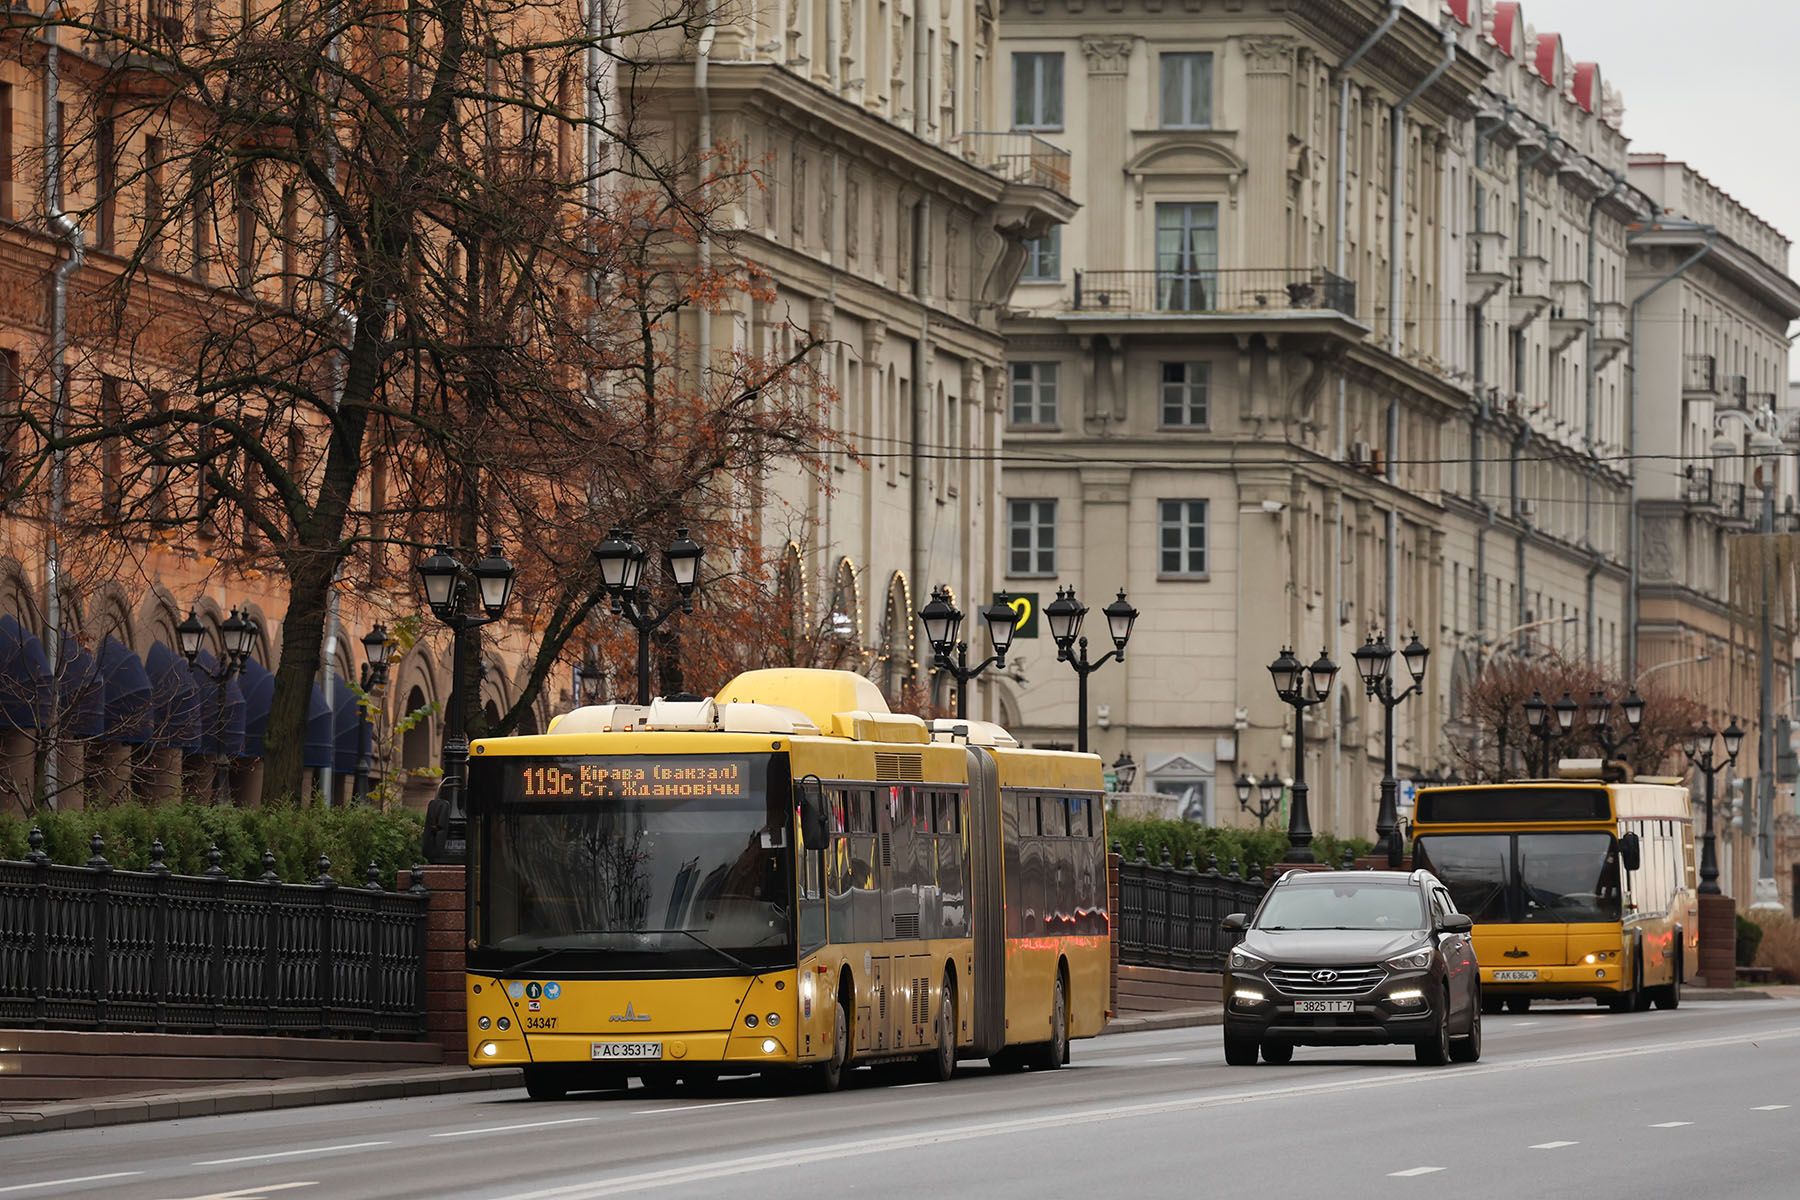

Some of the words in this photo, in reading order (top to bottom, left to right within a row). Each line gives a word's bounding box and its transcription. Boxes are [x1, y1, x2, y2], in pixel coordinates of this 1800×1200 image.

[580, 765, 645, 781] Кірава
[653, 764, 738, 780] (вакзал)
[580, 781, 614, 797] Ст.
[621, 780, 740, 796] Ждановічы
[527, 1017, 557, 1029] 34347
